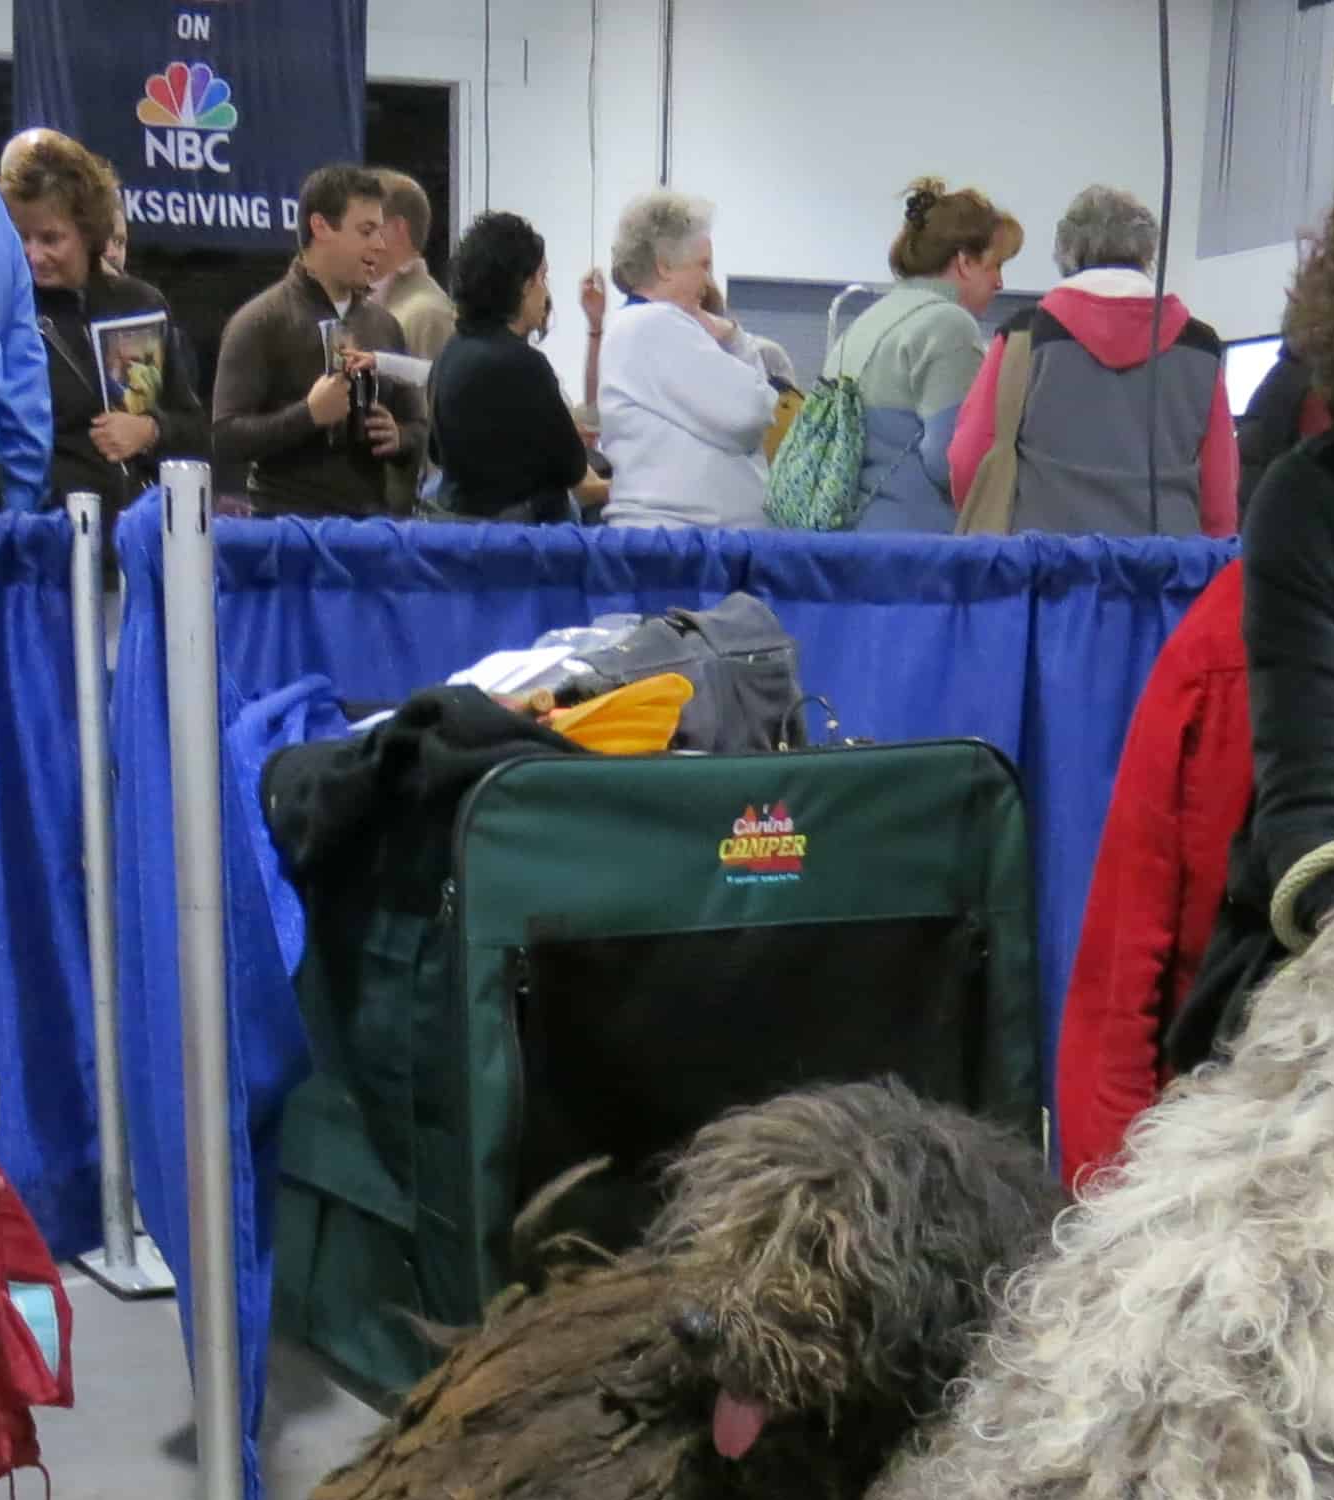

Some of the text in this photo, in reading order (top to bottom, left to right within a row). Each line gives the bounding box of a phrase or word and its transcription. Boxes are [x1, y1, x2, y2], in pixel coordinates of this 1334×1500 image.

[176, 13, 211, 41] ON
[144, 128, 231, 174] NBC
[116, 188, 271, 229] KSGIVING
[718, 835, 807, 860] CAMPER
